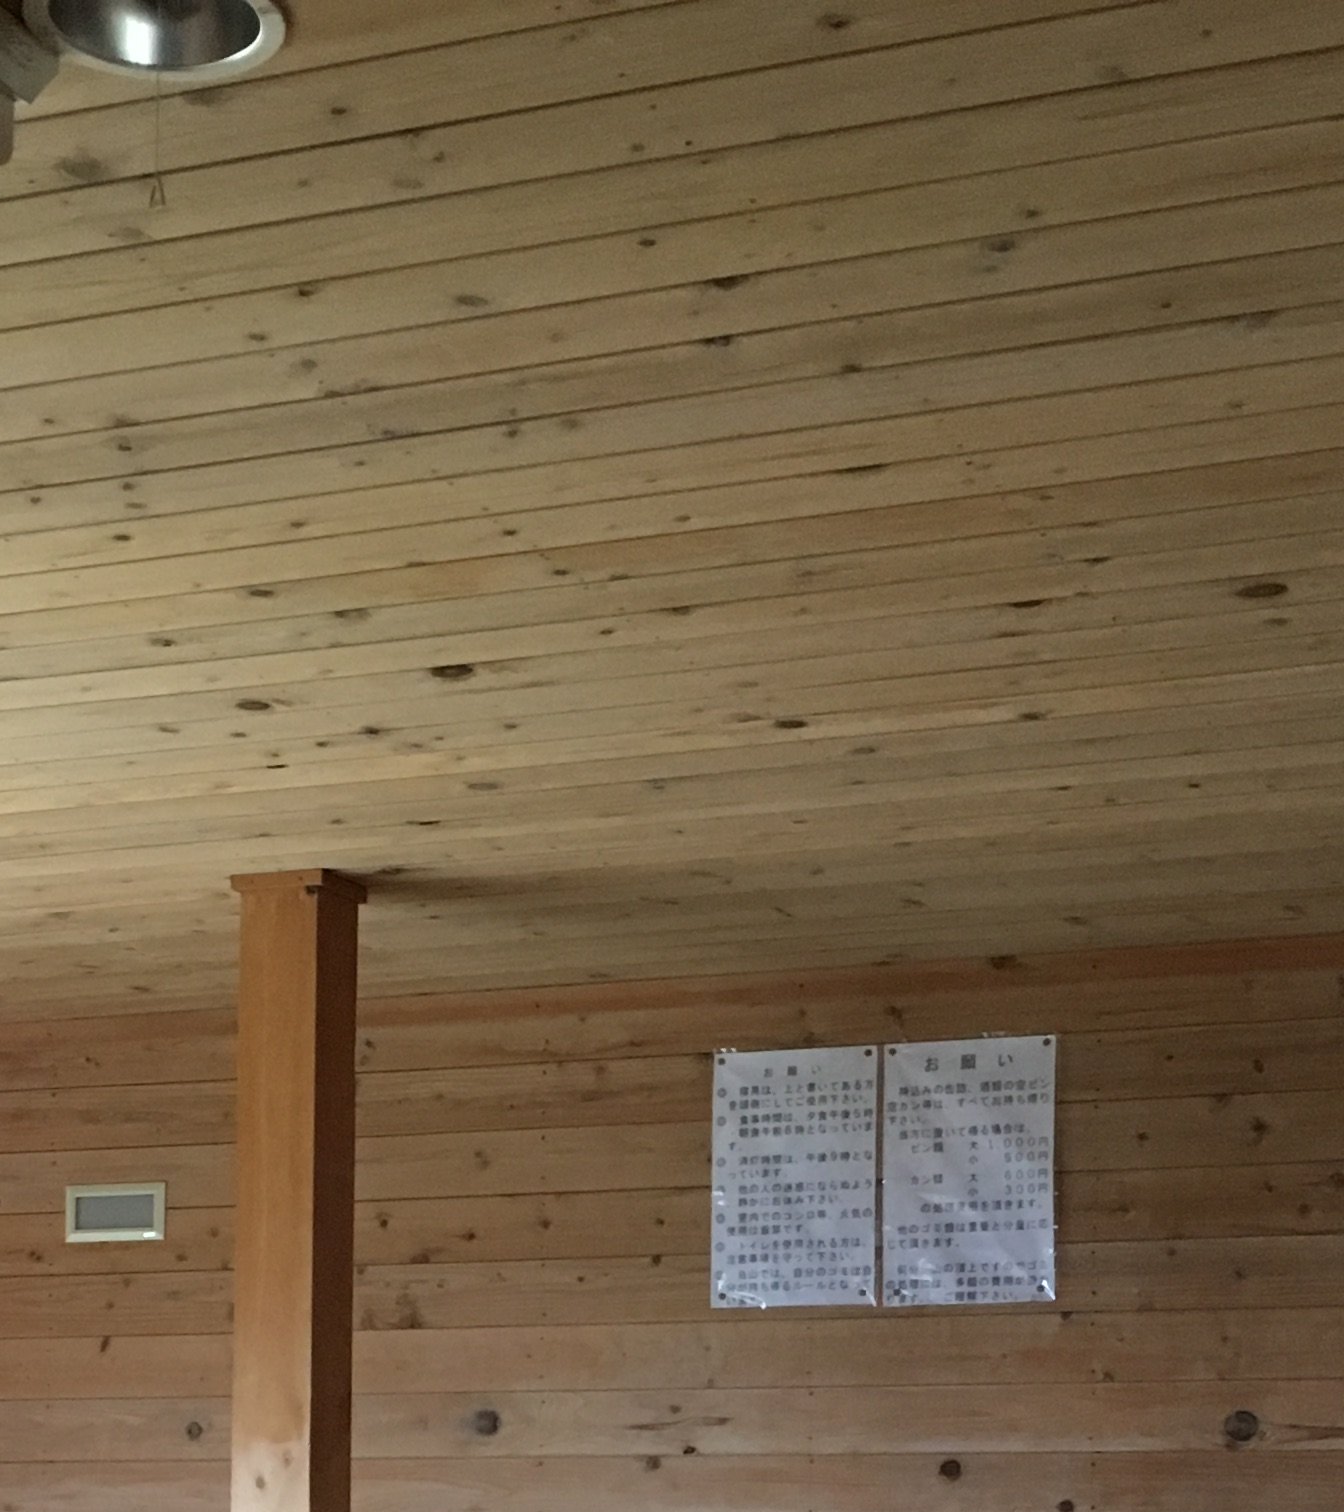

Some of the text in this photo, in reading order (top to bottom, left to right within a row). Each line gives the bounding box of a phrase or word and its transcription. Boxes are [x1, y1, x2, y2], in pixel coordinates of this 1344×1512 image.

[924, 1053, 1014, 1072] お願い
[763, 1064, 822, 1078] お願い
